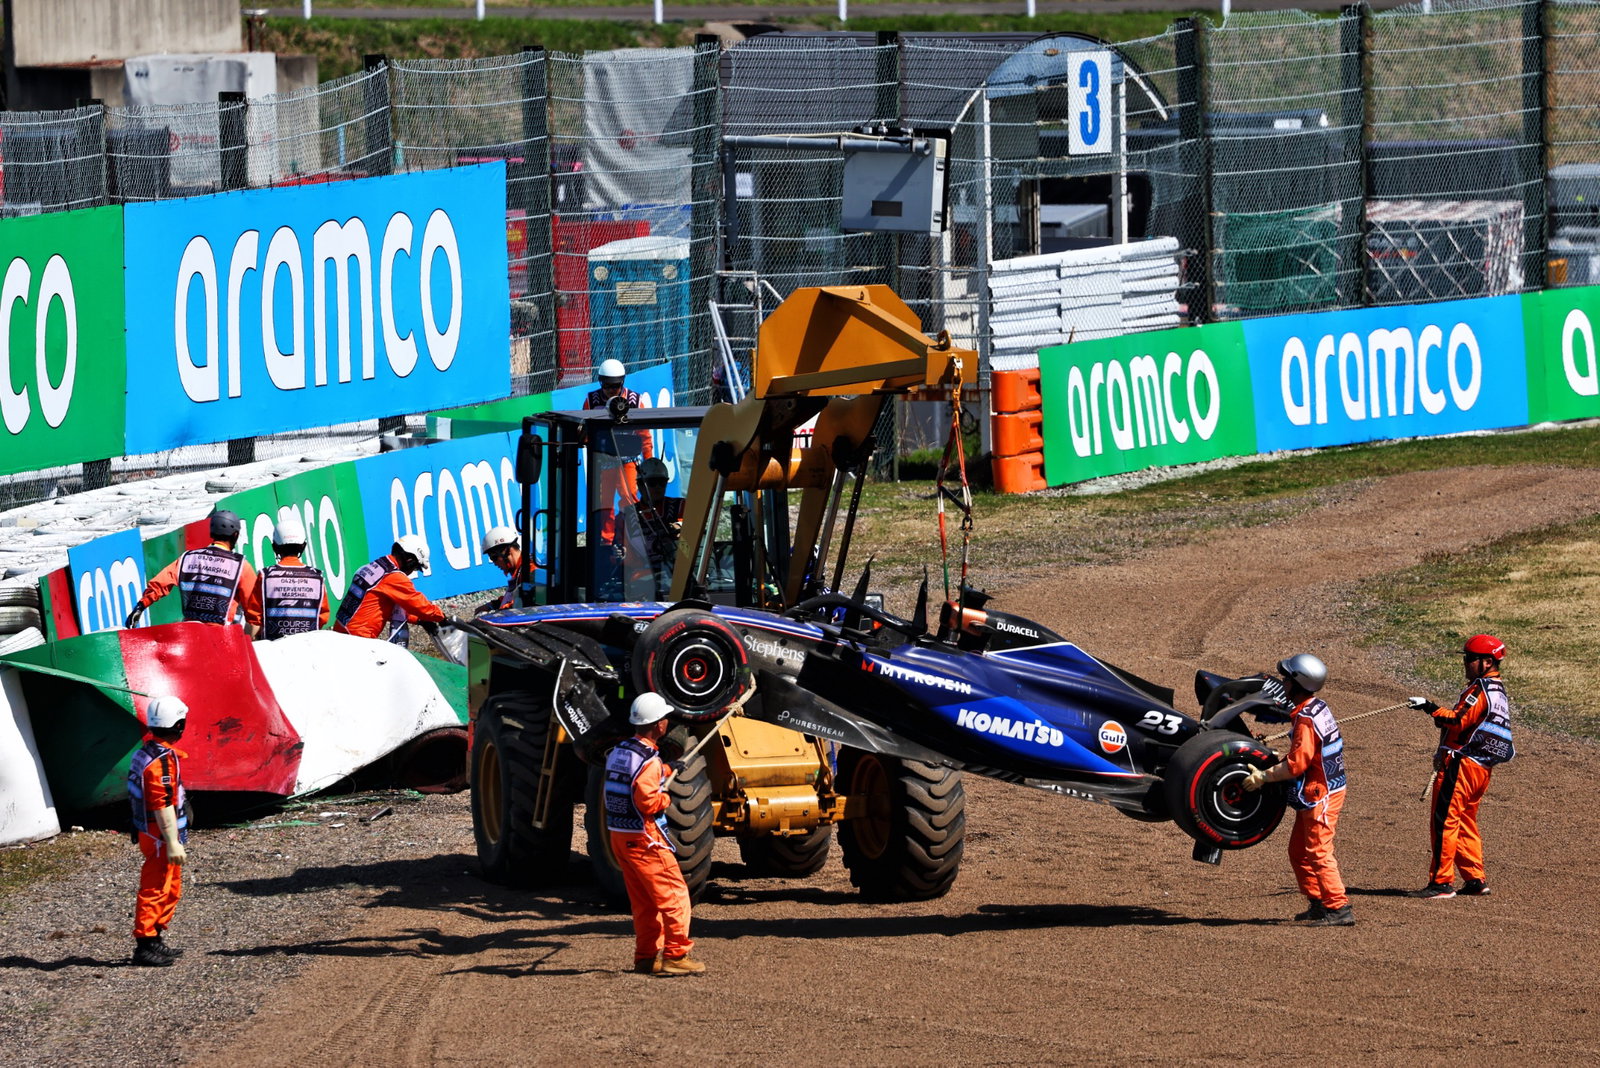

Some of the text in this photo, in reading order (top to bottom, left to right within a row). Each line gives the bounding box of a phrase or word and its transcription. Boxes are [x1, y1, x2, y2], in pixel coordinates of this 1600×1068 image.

[1079, 59, 1101, 146] 3
[174, 208, 463, 403] aramco
[1280, 321, 1482, 426] aramco
[1067, 348, 1220, 458] aramco
[390, 456, 543, 580] aramc
[277, 620, 310, 628] COURSE
[996, 622, 1039, 639] DURACELL
[743, 634, 805, 661] Stephens
[880, 663, 972, 695] MYPROTEIN
[789, 717, 845, 737] PURESTREAM
[956, 708, 1064, 747] KOMATSU
[1100, 730, 1125, 744] Gulf
[1136, 710, 1183, 735] 23
[1482, 744, 1508, 758] ACCESS
